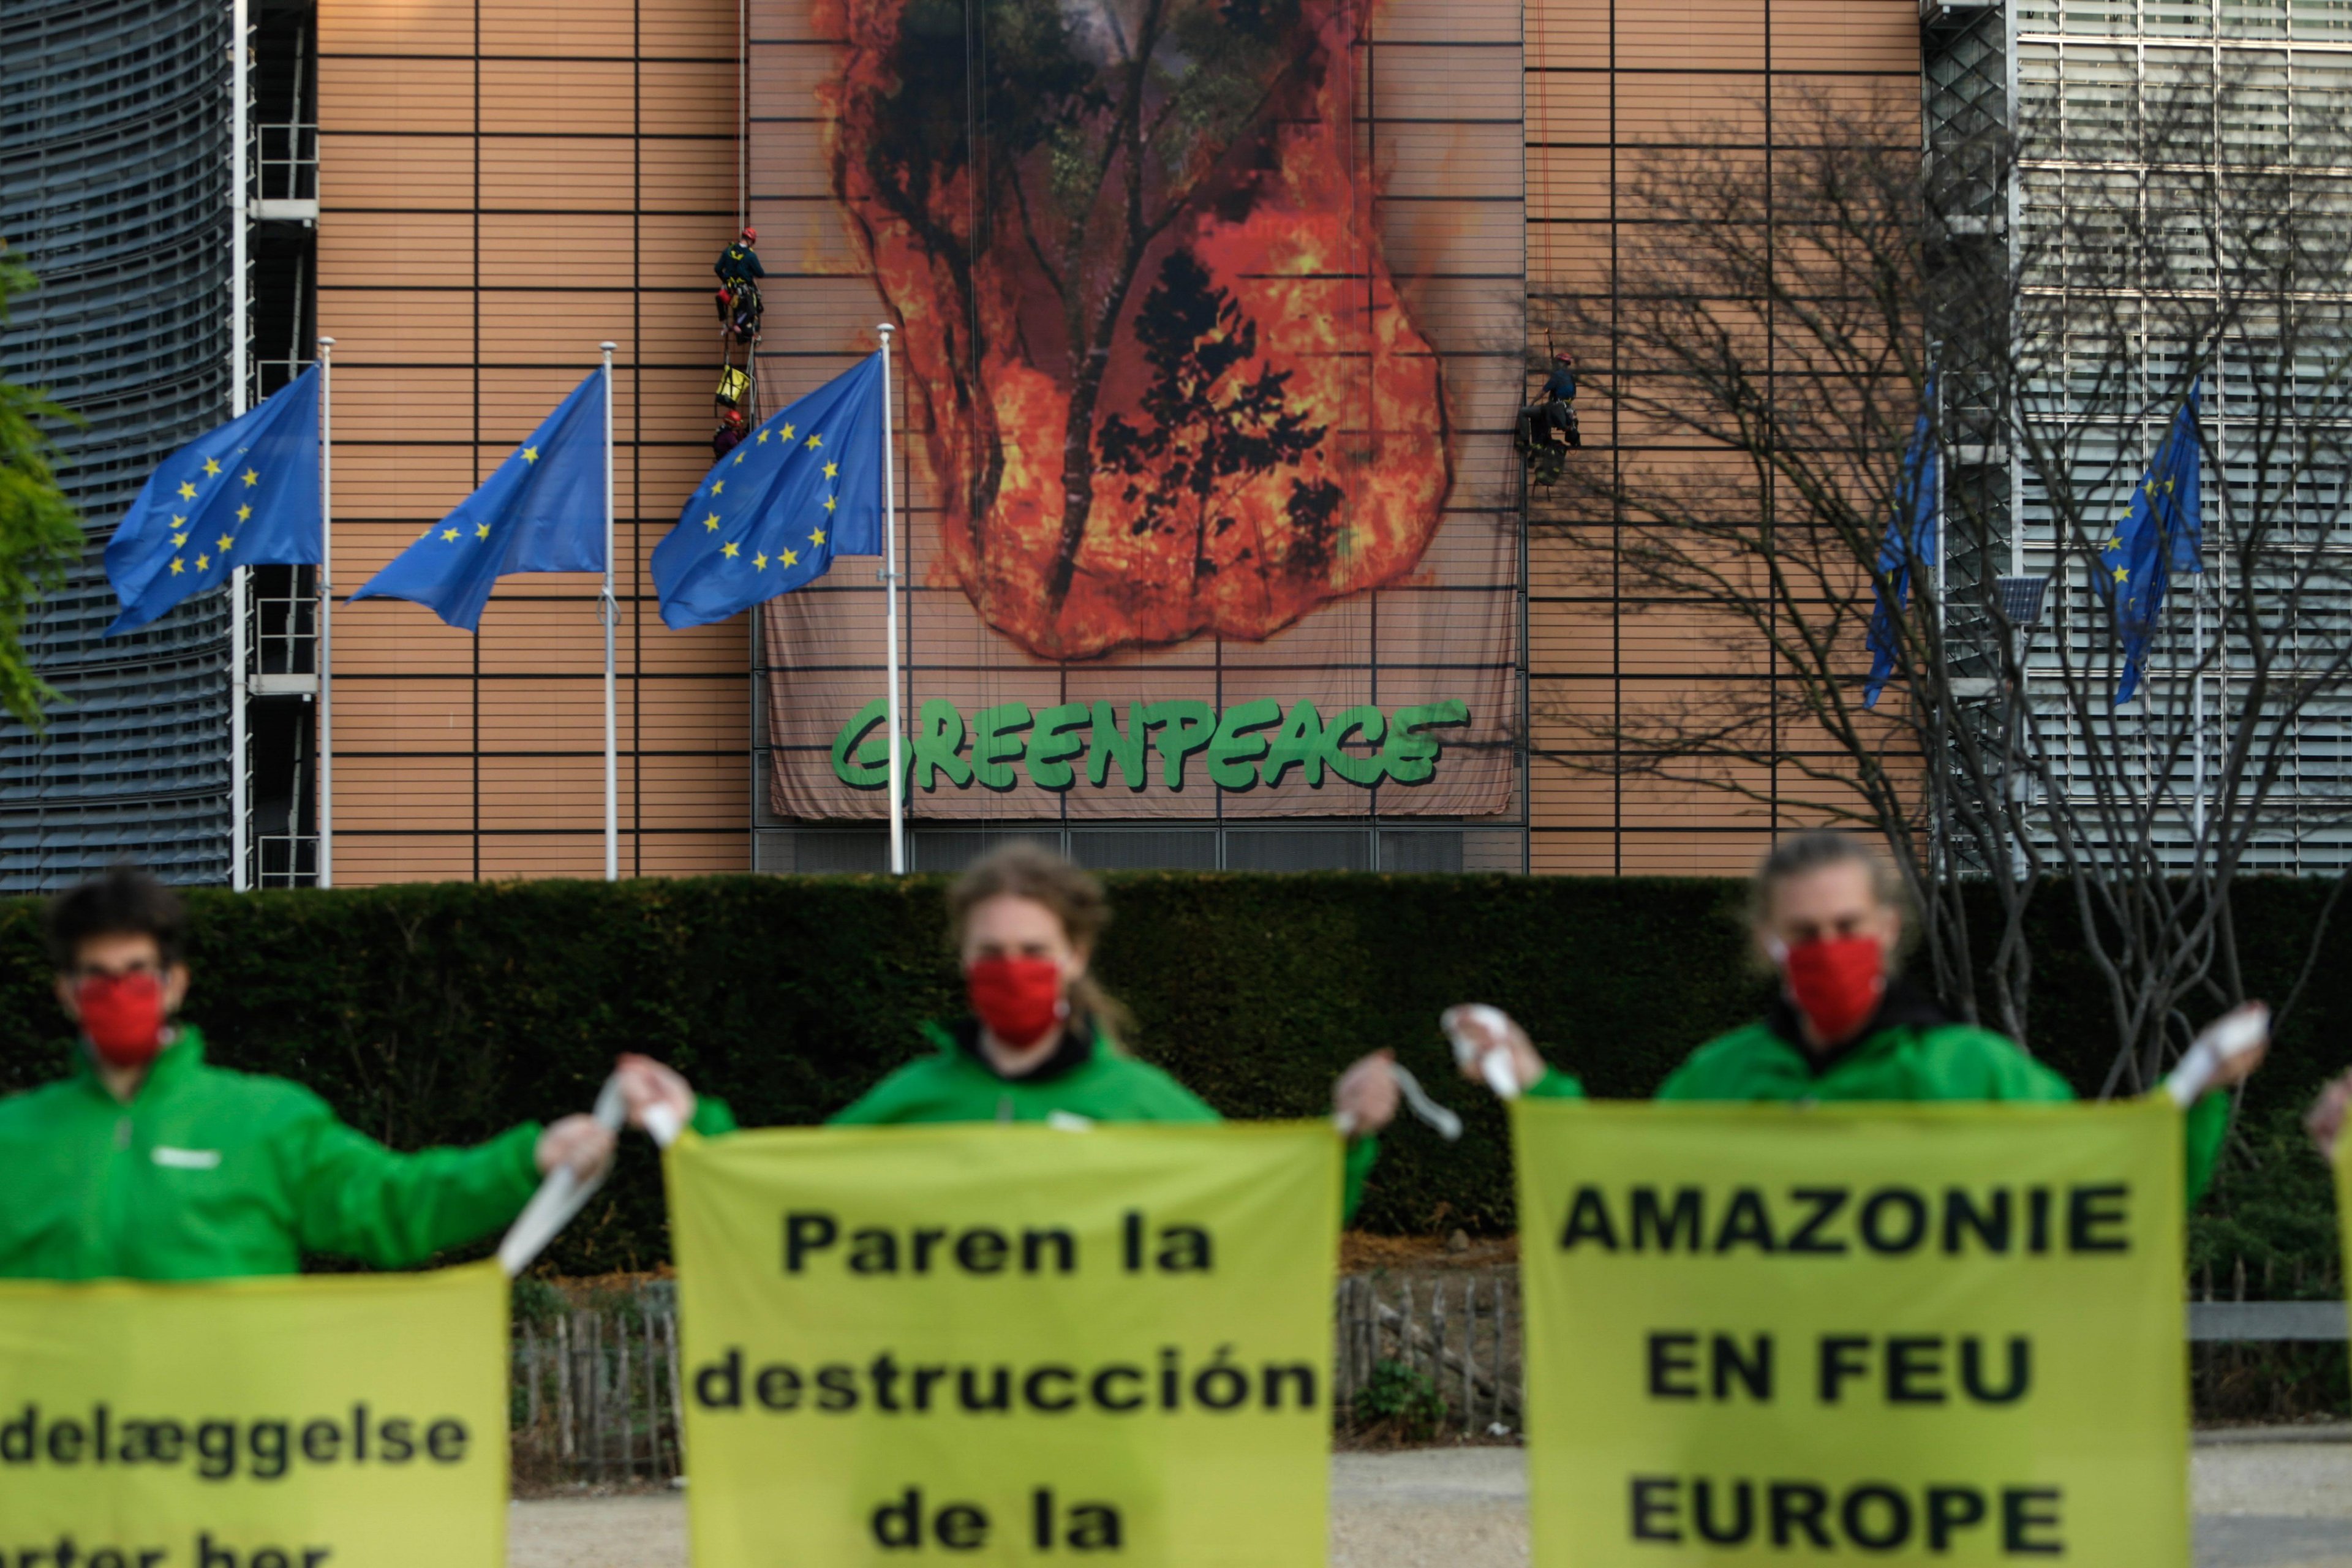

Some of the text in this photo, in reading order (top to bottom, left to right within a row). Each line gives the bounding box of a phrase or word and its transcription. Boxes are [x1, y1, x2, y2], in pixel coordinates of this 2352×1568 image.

[832, 697, 1471, 806] GREENPEACE
[783, 1210, 1214, 1276] Paren la
[1557, 1180, 2133, 1262] AMAZONIE
[693, 1344, 1317, 1415] destrucción
[1645, 1329, 2032, 1410] EN FEU
[0, 1403, 467, 1481] delæggelse
[869, 1485, 1124, 1553] de la
[1629, 1472, 2064, 1558] EUROPE
